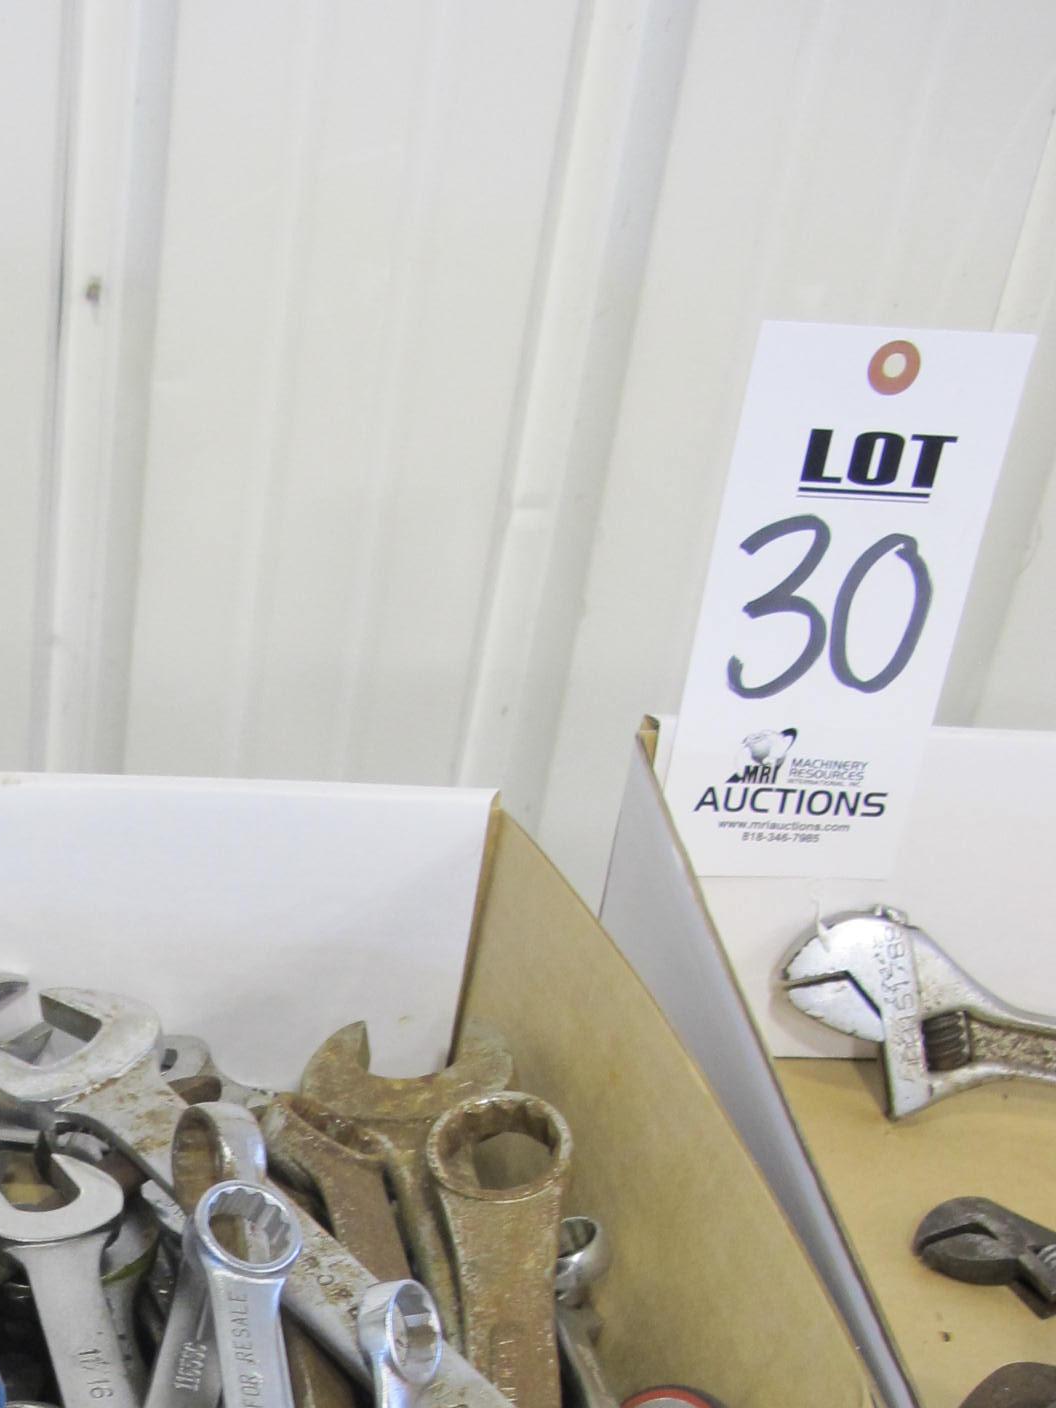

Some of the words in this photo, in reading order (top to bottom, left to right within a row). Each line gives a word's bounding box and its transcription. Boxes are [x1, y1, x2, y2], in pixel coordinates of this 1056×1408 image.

[800, 428, 958, 489] LOT
[727, 513, 933, 699] 30
[741, 764, 782, 785] MRI
[789, 768, 865, 782] RESOURCES
[790, 758, 868, 771] MACHINERY
[694, 786, 888, 818] AUCTIONS
[229, 1288, 254, 1363] RESALE
